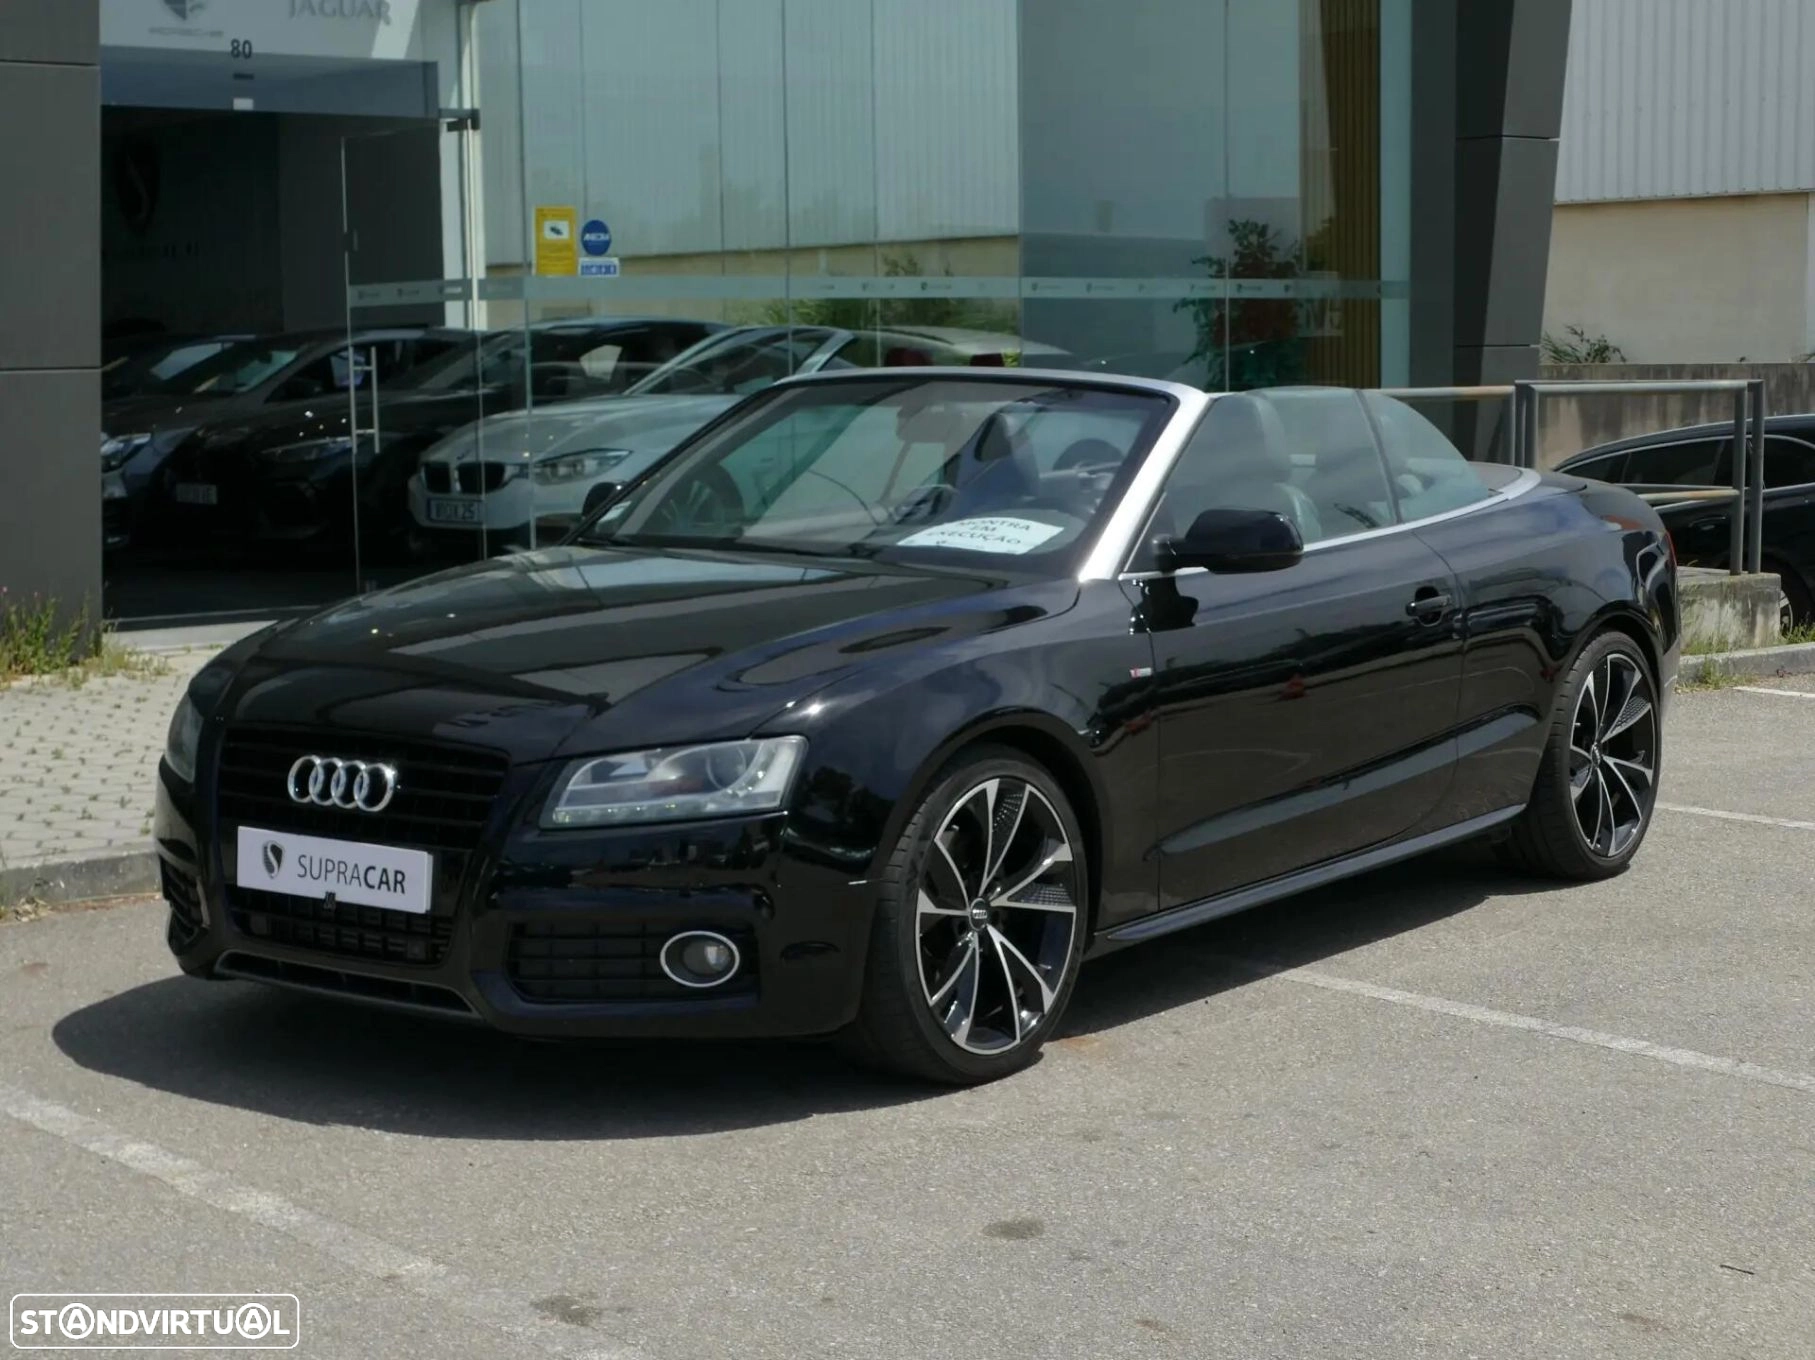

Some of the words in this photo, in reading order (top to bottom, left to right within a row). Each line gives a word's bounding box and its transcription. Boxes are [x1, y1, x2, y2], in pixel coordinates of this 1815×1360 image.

[289, 0, 392, 25] JAGUAR
[230, 38, 253, 58] 80
[297, 854, 406, 894] SUPRACAR
